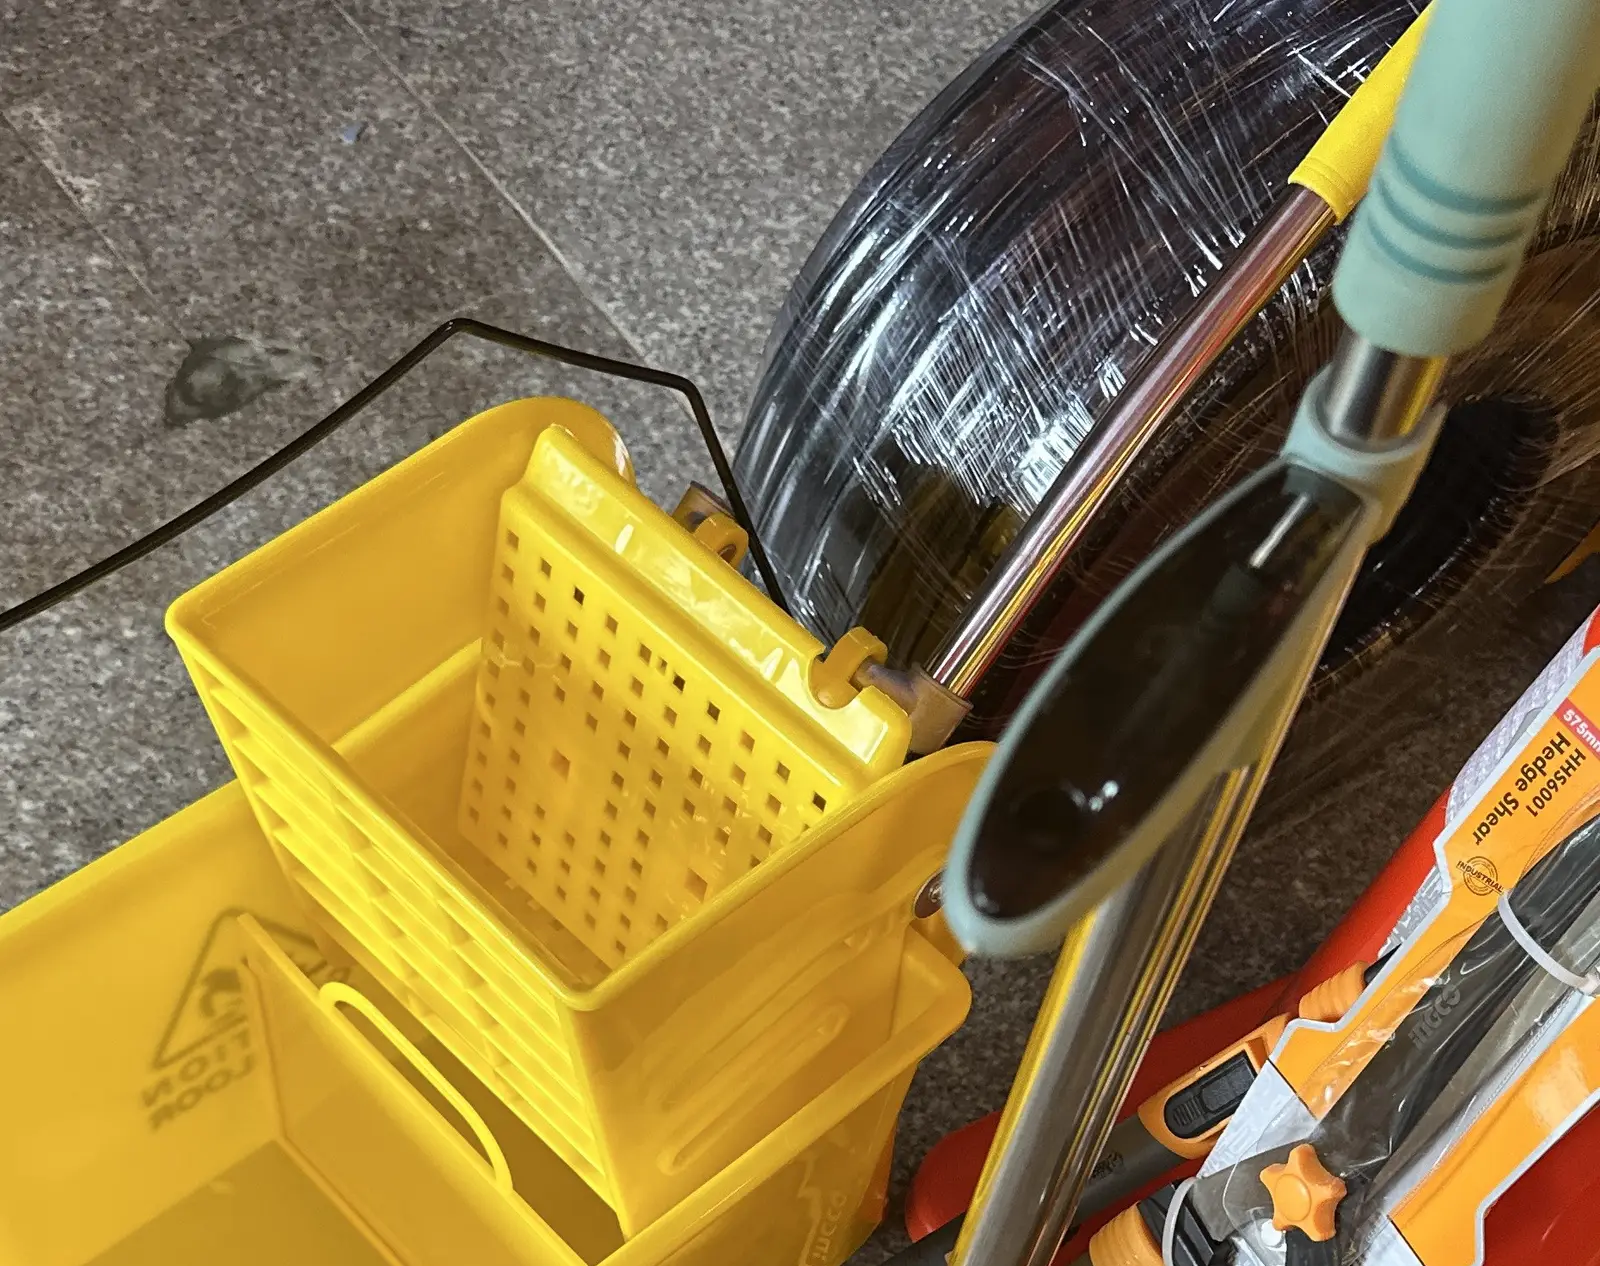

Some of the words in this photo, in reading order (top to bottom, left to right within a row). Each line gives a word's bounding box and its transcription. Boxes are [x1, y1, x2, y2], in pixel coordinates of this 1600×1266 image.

[1514, 731, 1572, 792] Hedge
[1525, 747, 1587, 818] HHS6001
[1472, 791, 1519, 846] Shear
[1456, 860, 1503, 894] INDUSTRIAL
